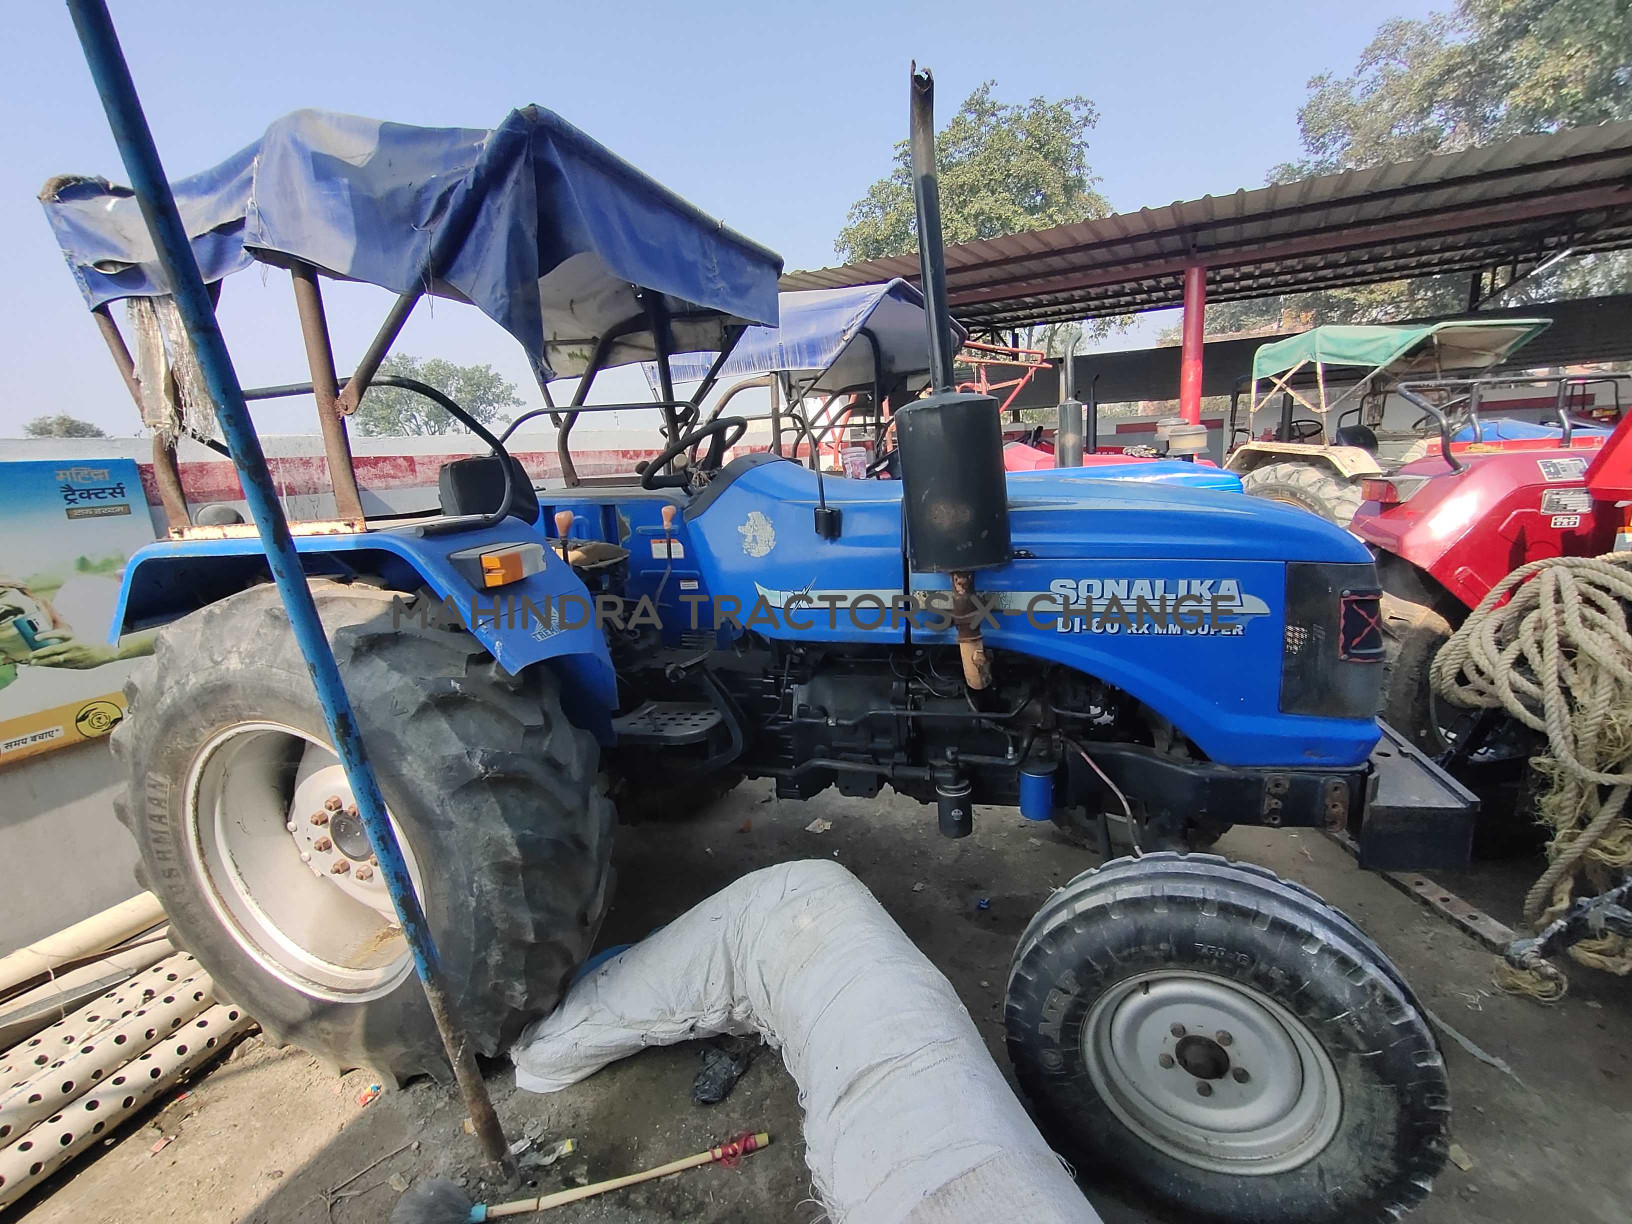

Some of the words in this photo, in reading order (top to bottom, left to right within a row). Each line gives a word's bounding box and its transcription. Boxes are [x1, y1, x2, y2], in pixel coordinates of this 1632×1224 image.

[60, 482, 126, 505] ट्रैक्टर्स
[1050, 579, 1243, 606] SONALIKA
[1056, 617, 1121, 634] DI-60
